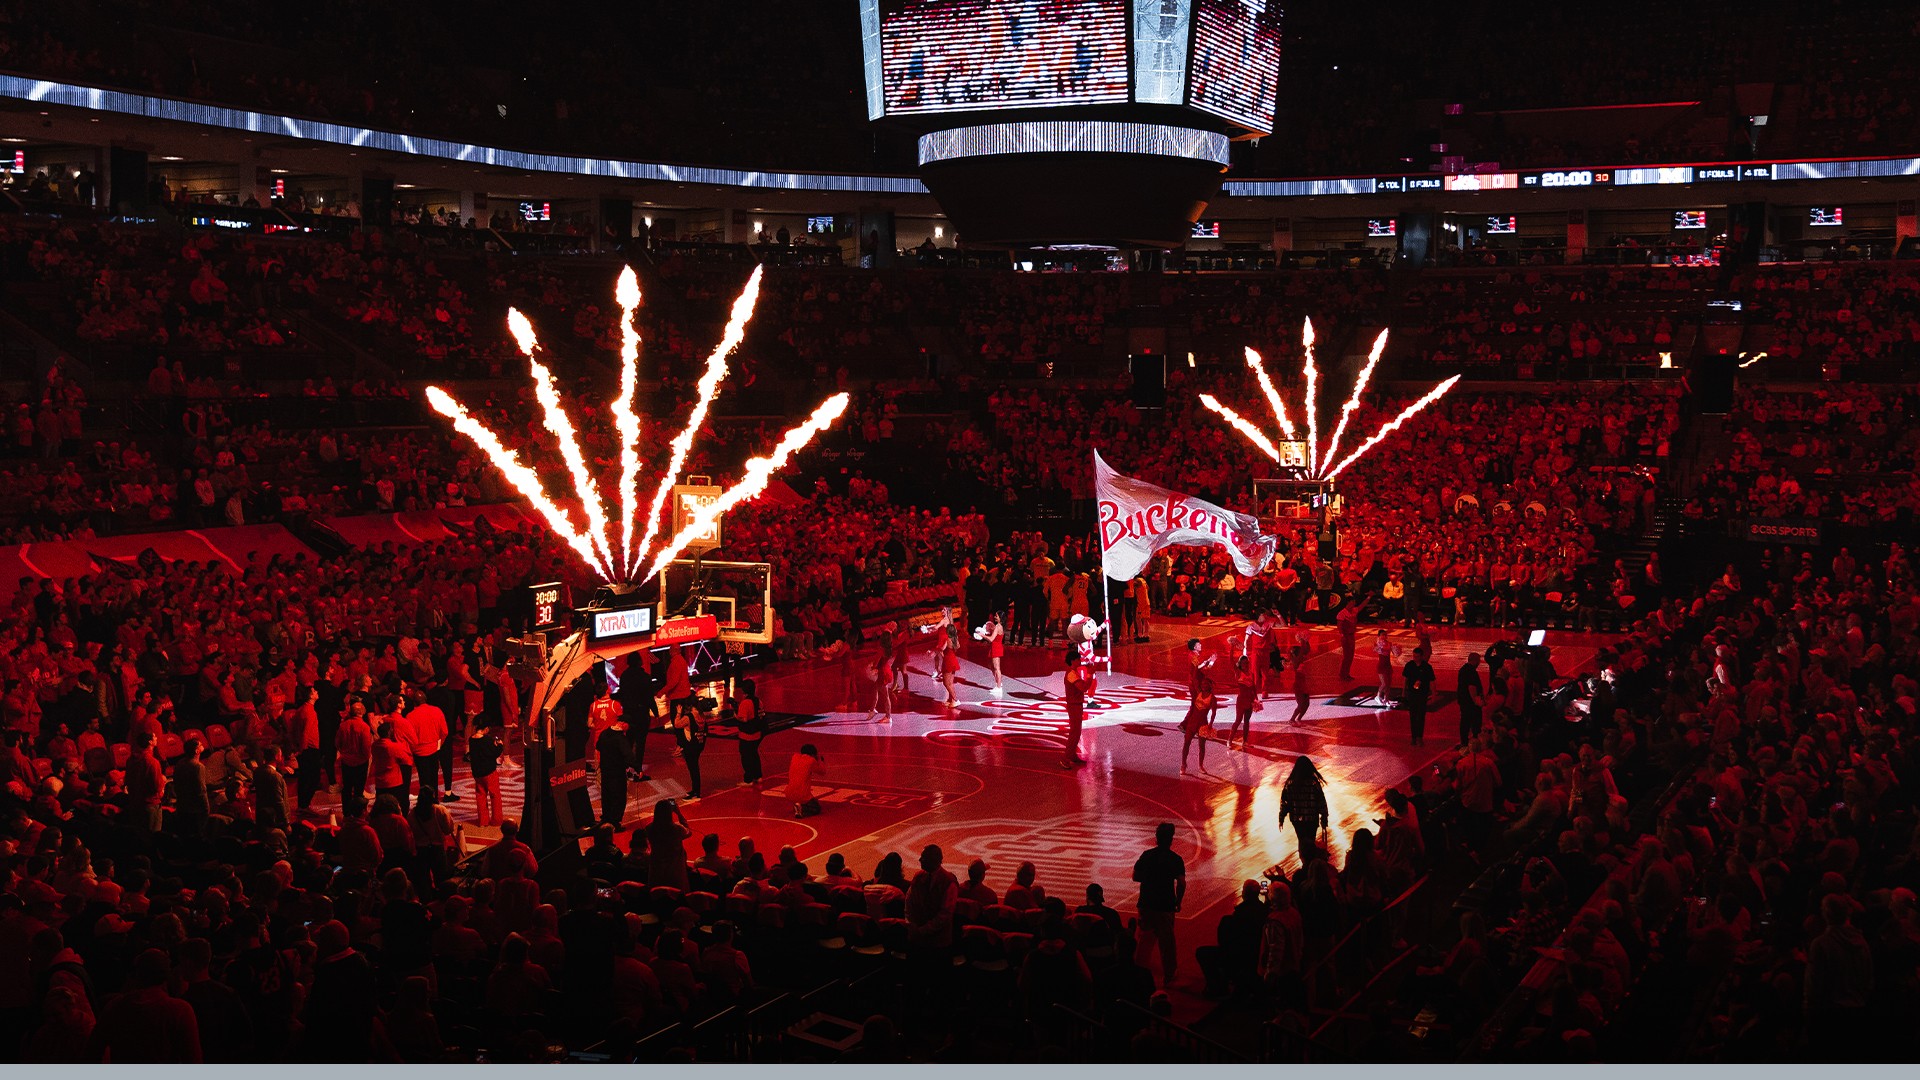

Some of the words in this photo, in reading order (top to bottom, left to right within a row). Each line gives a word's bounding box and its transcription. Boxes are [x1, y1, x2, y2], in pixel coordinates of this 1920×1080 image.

[1541, 171, 1592, 187] 20:00
[1595, 173, 1609, 182] 30
[1706, 169, 1735, 178] FOULS
[1759, 524, 1777, 535] CBS
[1778, 525, 1818, 538] SPORTS
[539, 605, 552, 623] 30
[599, 612, 647, 633] XTRATUF
[550, 769, 586, 787] Safelite
